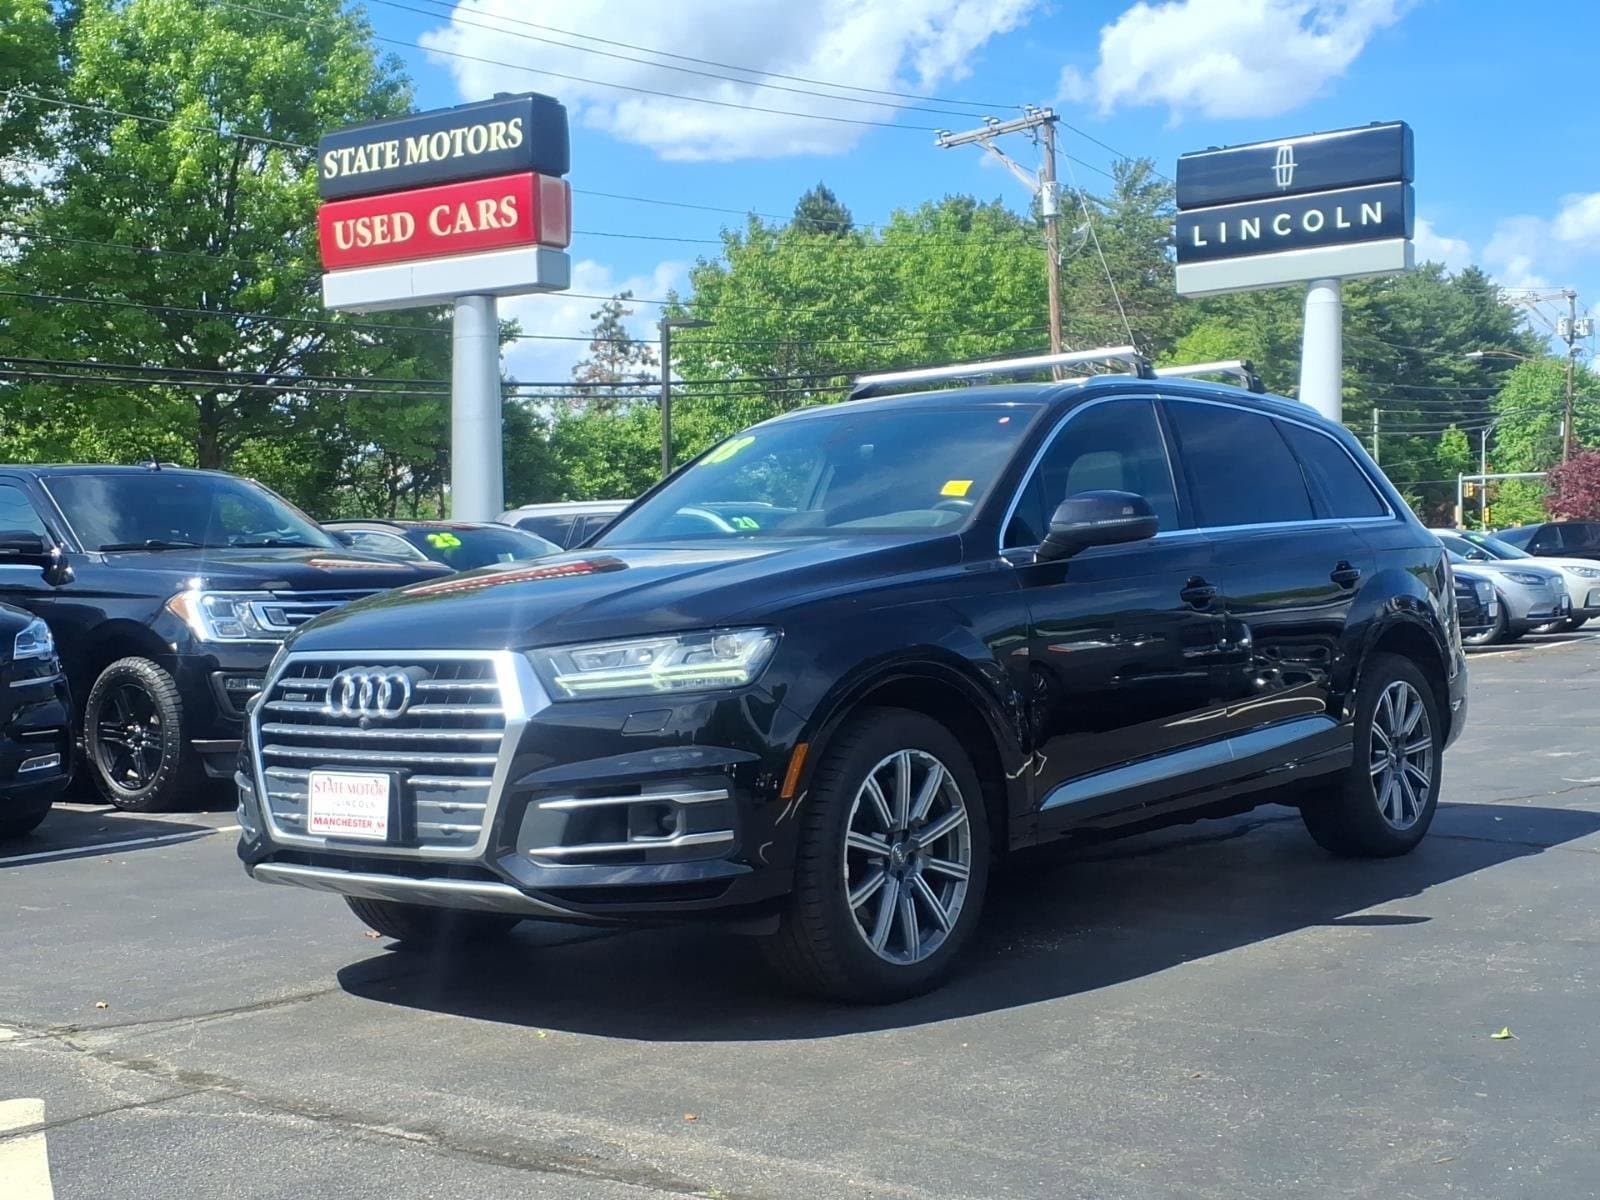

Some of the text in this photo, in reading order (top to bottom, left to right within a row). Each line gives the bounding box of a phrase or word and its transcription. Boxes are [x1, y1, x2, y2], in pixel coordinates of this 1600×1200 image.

[324, 118, 523, 179] STATE MOTORS
[334, 195, 519, 249] USED CARS
[1193, 201, 1383, 247] LINCOLN
[314, 781, 343, 794] STATE
[313, 817, 372, 829] MANCHESTER
